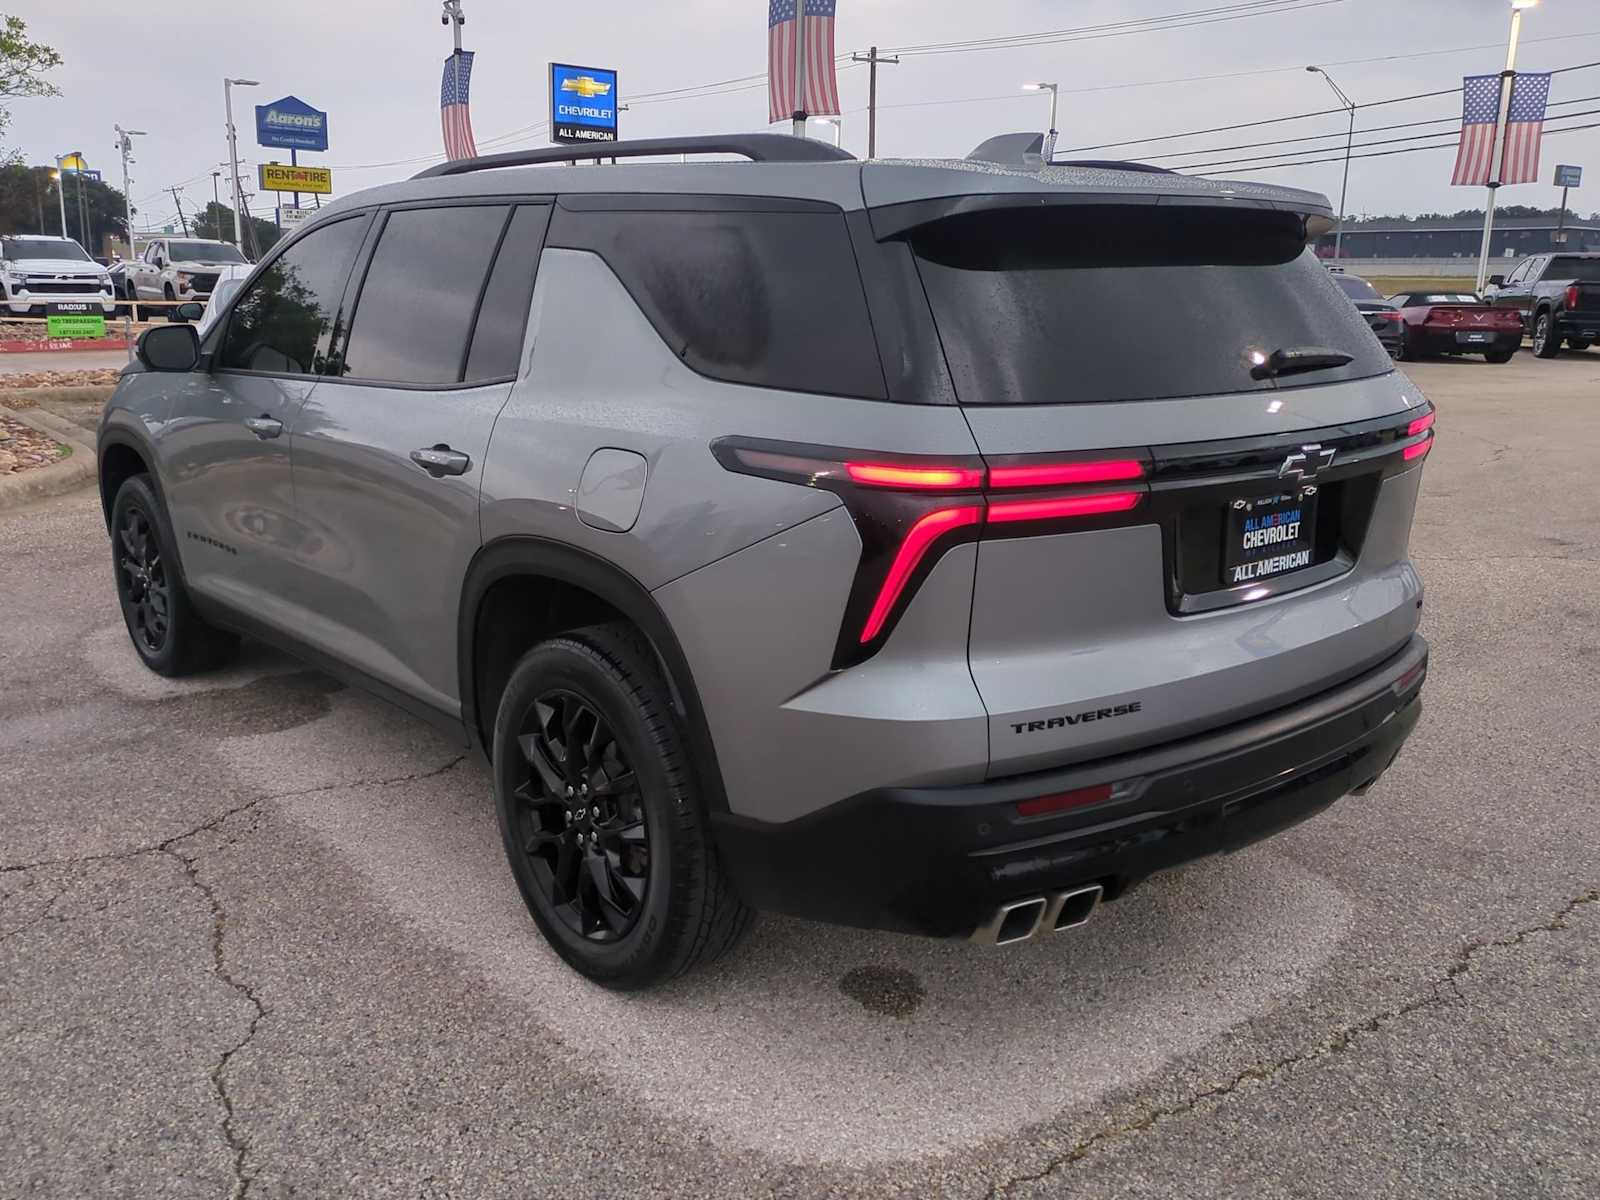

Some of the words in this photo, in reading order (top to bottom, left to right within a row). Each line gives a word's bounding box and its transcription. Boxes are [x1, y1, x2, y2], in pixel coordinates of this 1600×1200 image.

[266, 110, 322, 128] Aaron's
[559, 105, 612, 119] CHEVROLET
[559, 128, 573, 137] ALL
[575, 130, 614, 140] AMERICAN
[267, 168, 296, 180] RENT
[303, 171, 327, 183] TIRE
[57, 303, 87, 311] RADIUS
[1244, 518, 1260, 531] ALL
[1261, 509, 1301, 529] AMERICAN
[1243, 522, 1300, 549] CHEVROLET
[1234, 564, 1255, 582] ALL
[1256, 550, 1311, 576] AMERICAN
[1010, 701, 1142, 734] TRAVERSE
